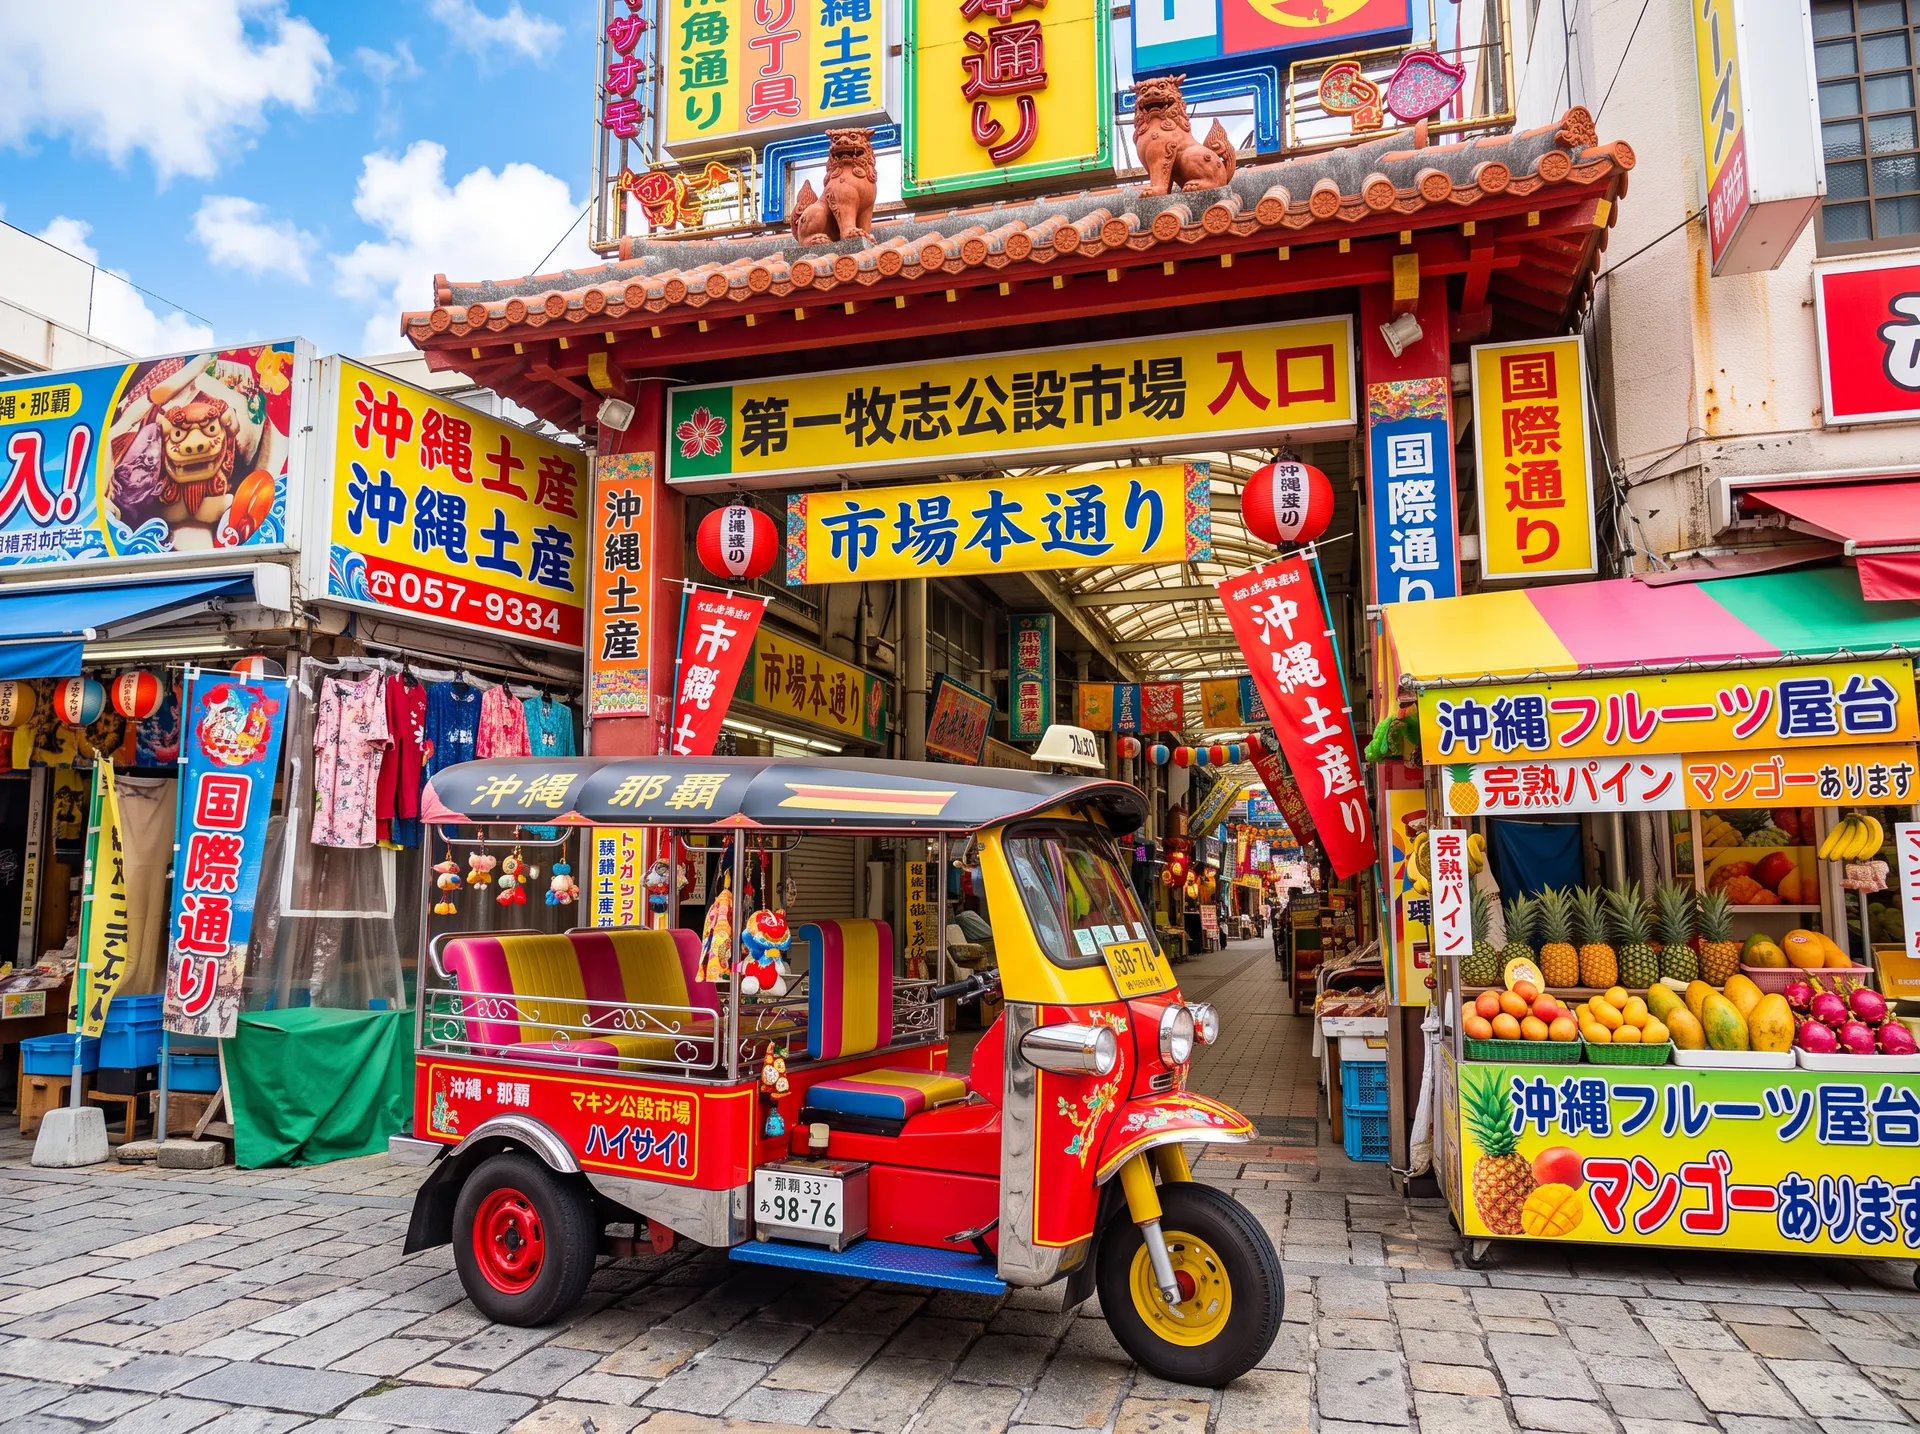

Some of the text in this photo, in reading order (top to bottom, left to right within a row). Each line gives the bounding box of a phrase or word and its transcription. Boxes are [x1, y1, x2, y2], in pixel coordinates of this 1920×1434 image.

[603, 0, 648, 139] サオモ
[740, 343, 1336, 457] 第一牧志公設市場 入口
[353, 380, 580, 520] 沖縄土産
[1500, 351, 1566, 564] 国際通り
[347, 461, 576, 593] 沖縄土産
[820, 479, 1165, 574] 市場本通り
[399, 571, 561, 634] 057-9334
[600, 488, 642, 661] 沖縄土産
[760, 642, 861, 727] 市場本通り
[1250, 594, 1366, 843] 沖縄土産り
[1437, 674, 1898, 755] 沖縄フルーツ屋台
[470, 772, 732, 811] 沖縄 那覇
[1483, 760, 1675, 809] 完熟パイン
[1688, 755, 1915, 802] マンゴーあります
[175, 771, 252, 1017] 国際通り
[1436, 834, 1465, 951] 完熟パイン
[449, 1074, 531, 1108] 沖縄・那覇
[570, 1090, 691, 1126] マキシ公設市場
[1511, 1076, 1920, 1146] 沖縄フルーツ屋台
[760, 1195, 836, 1228] あ 98-76
